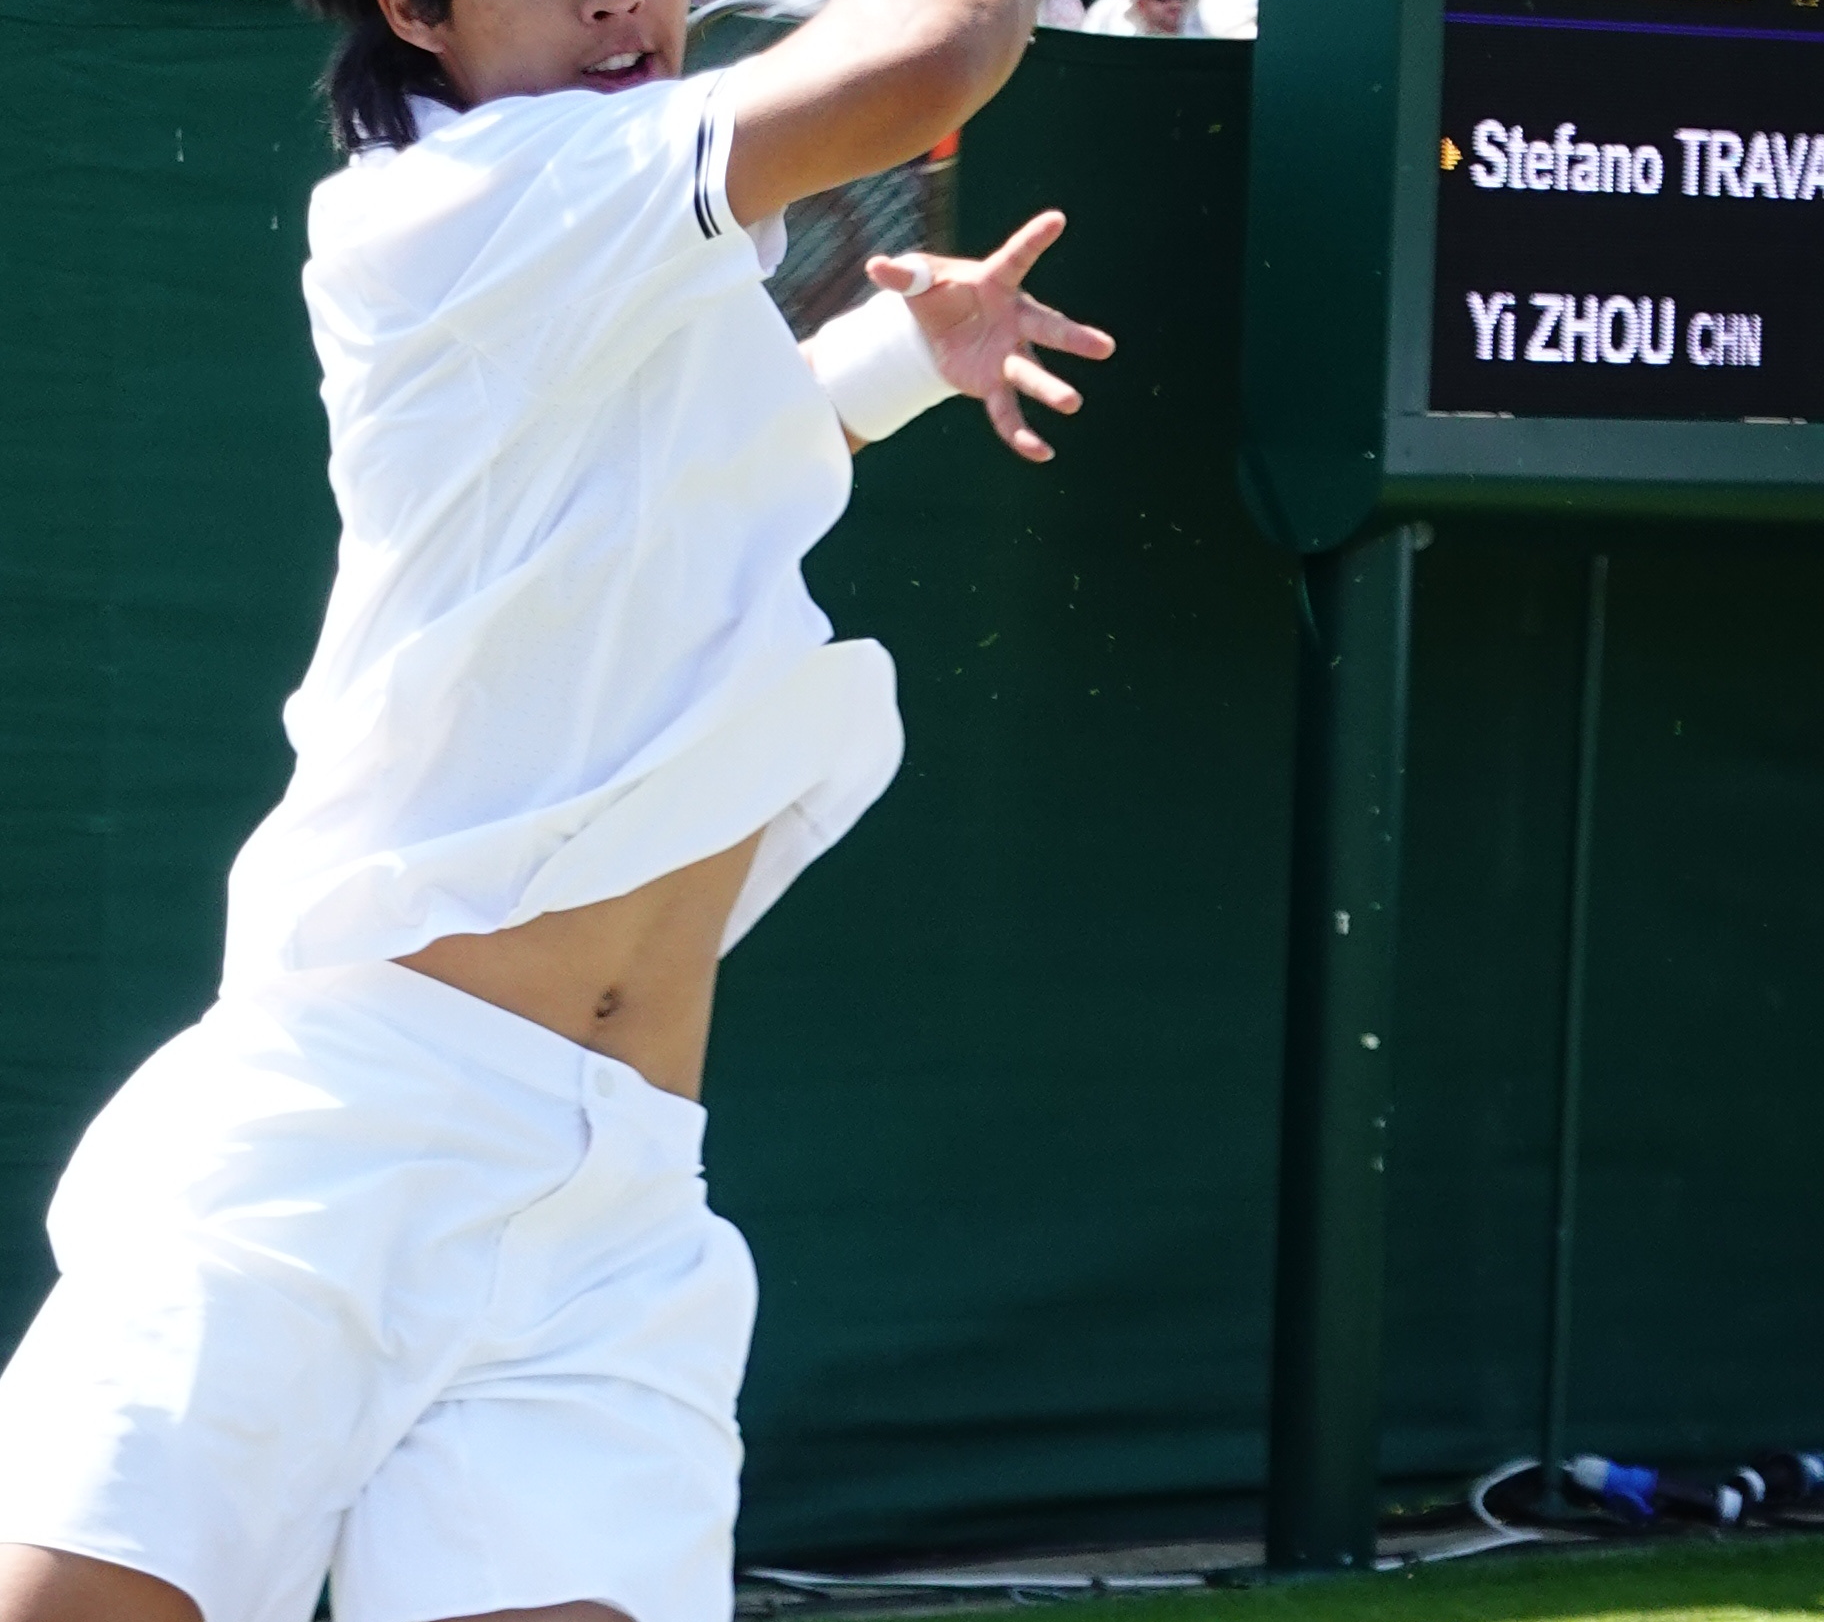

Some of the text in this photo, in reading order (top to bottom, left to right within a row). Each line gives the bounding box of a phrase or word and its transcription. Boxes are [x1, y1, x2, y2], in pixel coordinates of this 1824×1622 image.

[1469, 118, 1824, 200] Stefano TRAVA
[1466, 290, 1762, 367] Yi ZHOU CHN
